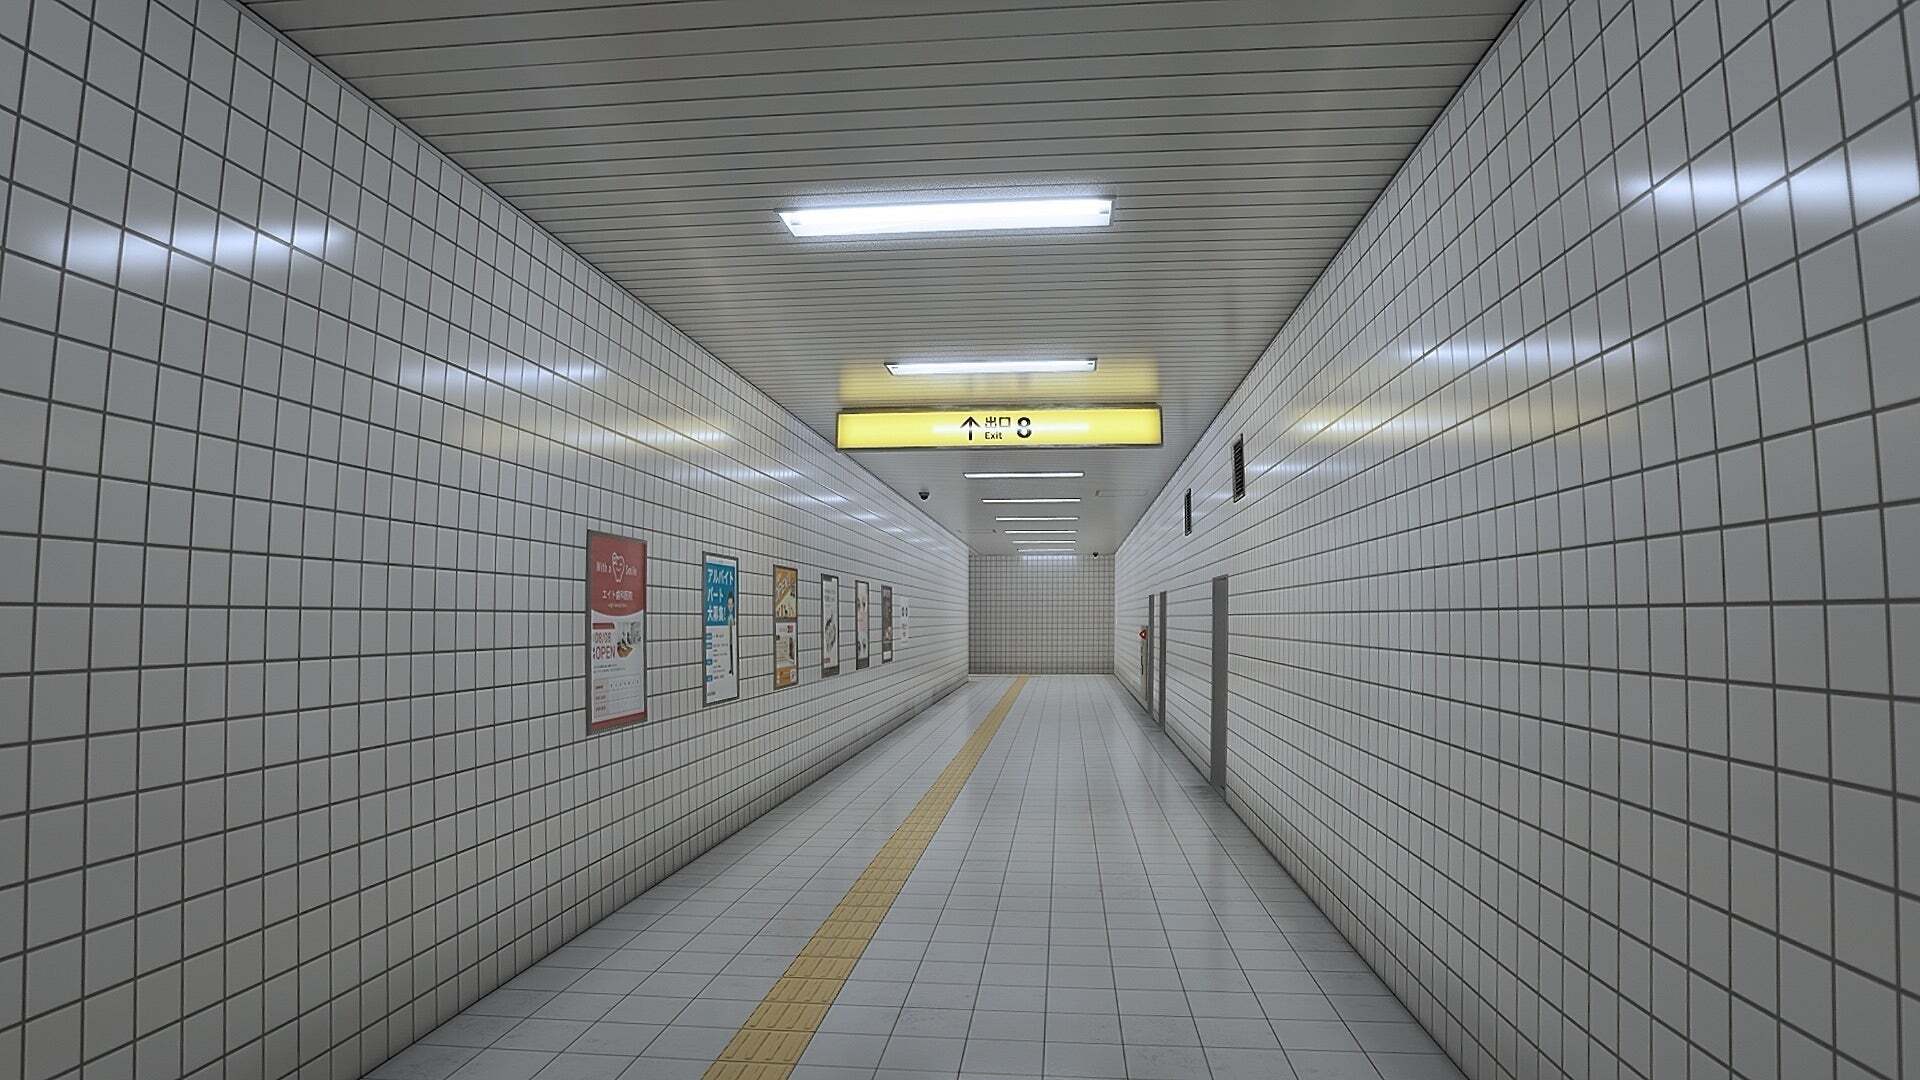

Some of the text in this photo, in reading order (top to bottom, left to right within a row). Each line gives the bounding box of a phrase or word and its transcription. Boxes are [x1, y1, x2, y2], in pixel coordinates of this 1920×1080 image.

[985, 416, 1011, 428] 出口
[1016, 417, 1032, 438] 8
[984, 431, 1003, 440] Exit
[707, 568, 734, 586] アルバイト
[707, 586, 724, 603] パート
[595, 646, 616, 660] OPEN
